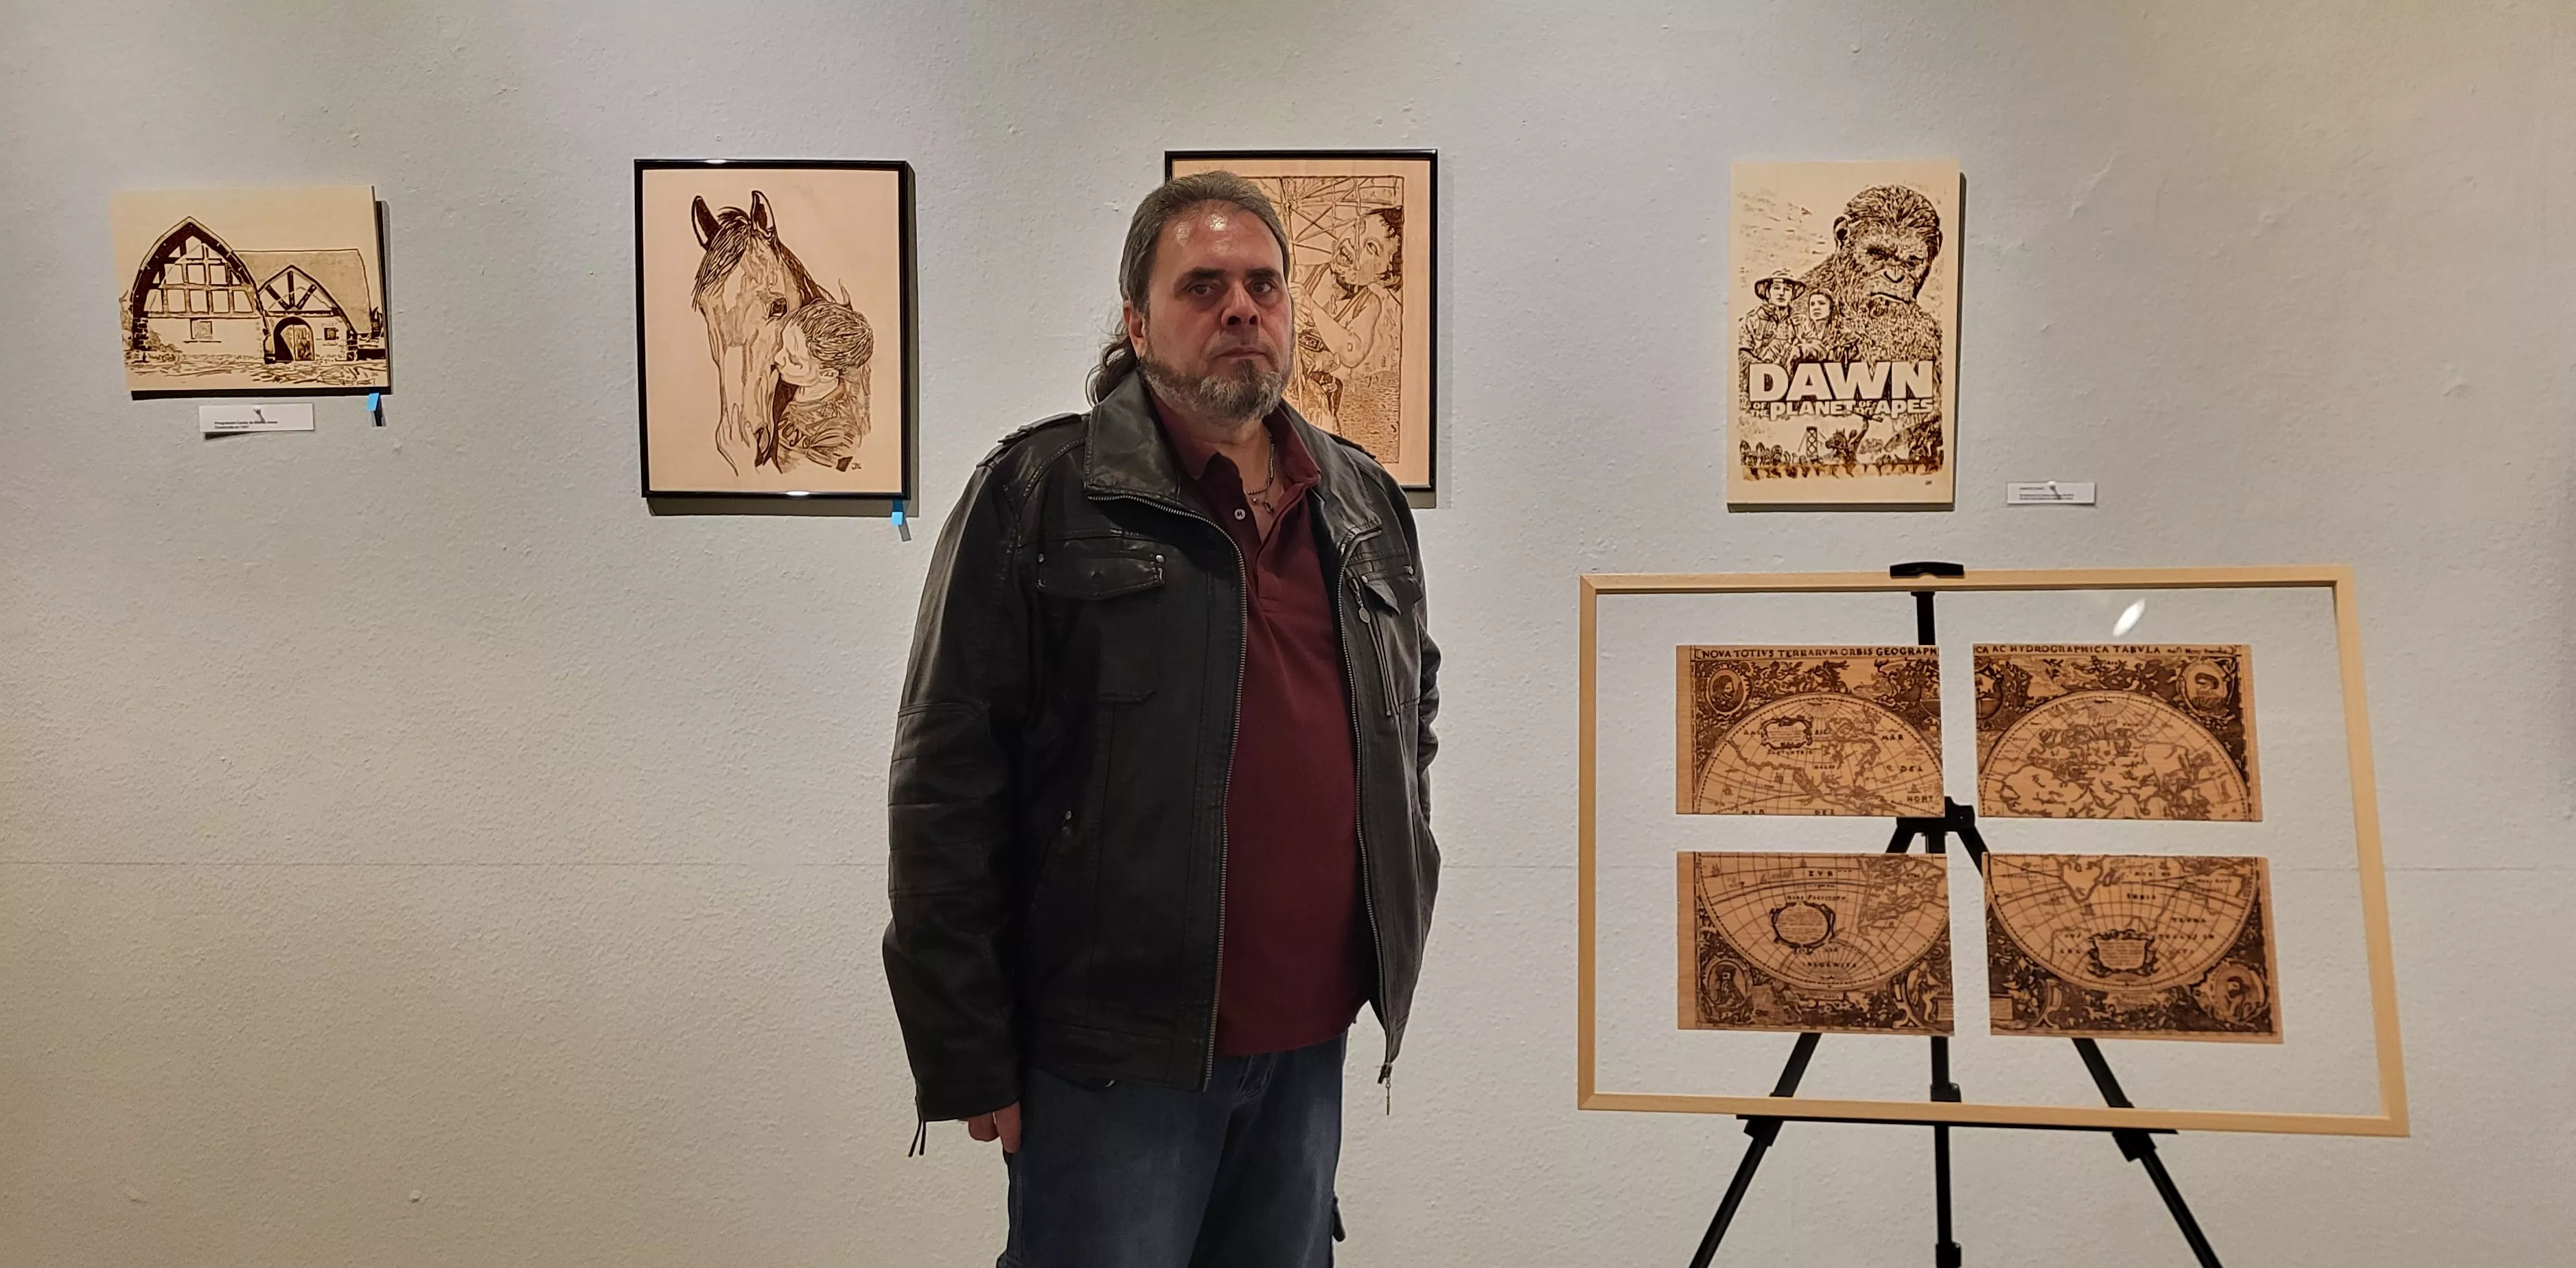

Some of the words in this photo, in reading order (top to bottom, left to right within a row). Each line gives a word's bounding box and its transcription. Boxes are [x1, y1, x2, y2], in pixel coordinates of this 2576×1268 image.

[1750, 361, 1934, 401] DAWN
[1752, 402, 1767, 410] OF
[1770, 400, 1855, 421] PLANET
[1876, 399, 1934, 419] APES
[1702, 649, 1732, 658] NOVA
[1733, 649, 1774, 658] TOTIVS
[1777, 648, 1838, 657] TERRARVM
[1841, 647, 1873, 656] ORBIS
[2113, 646, 2161, 654] TABVLA
